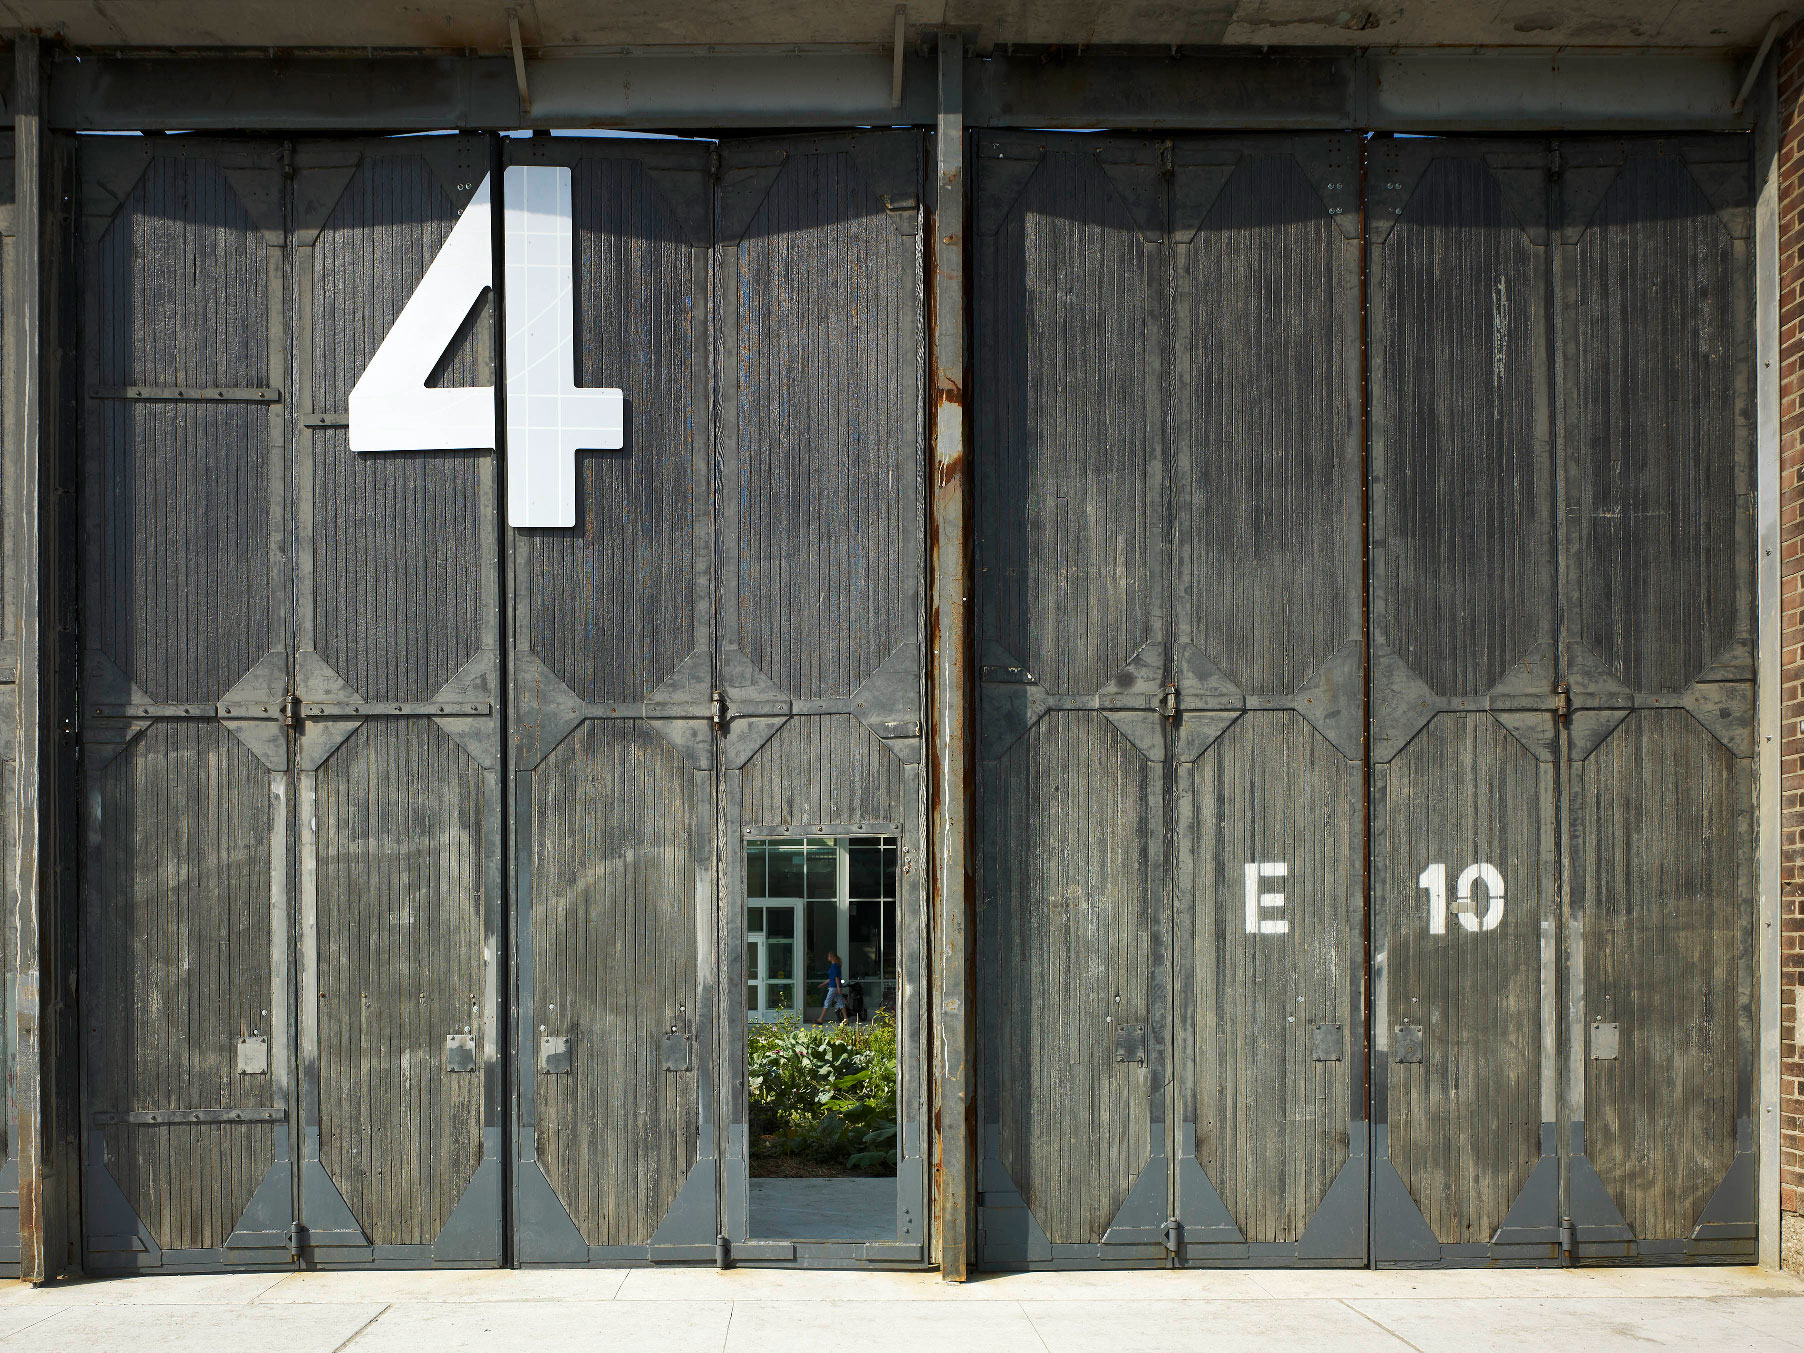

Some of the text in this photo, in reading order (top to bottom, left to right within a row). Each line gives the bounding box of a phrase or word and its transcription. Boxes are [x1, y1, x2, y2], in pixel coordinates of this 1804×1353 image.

[348, 165, 624, 528] 4
[1244, 862, 1505, 935] E 10
